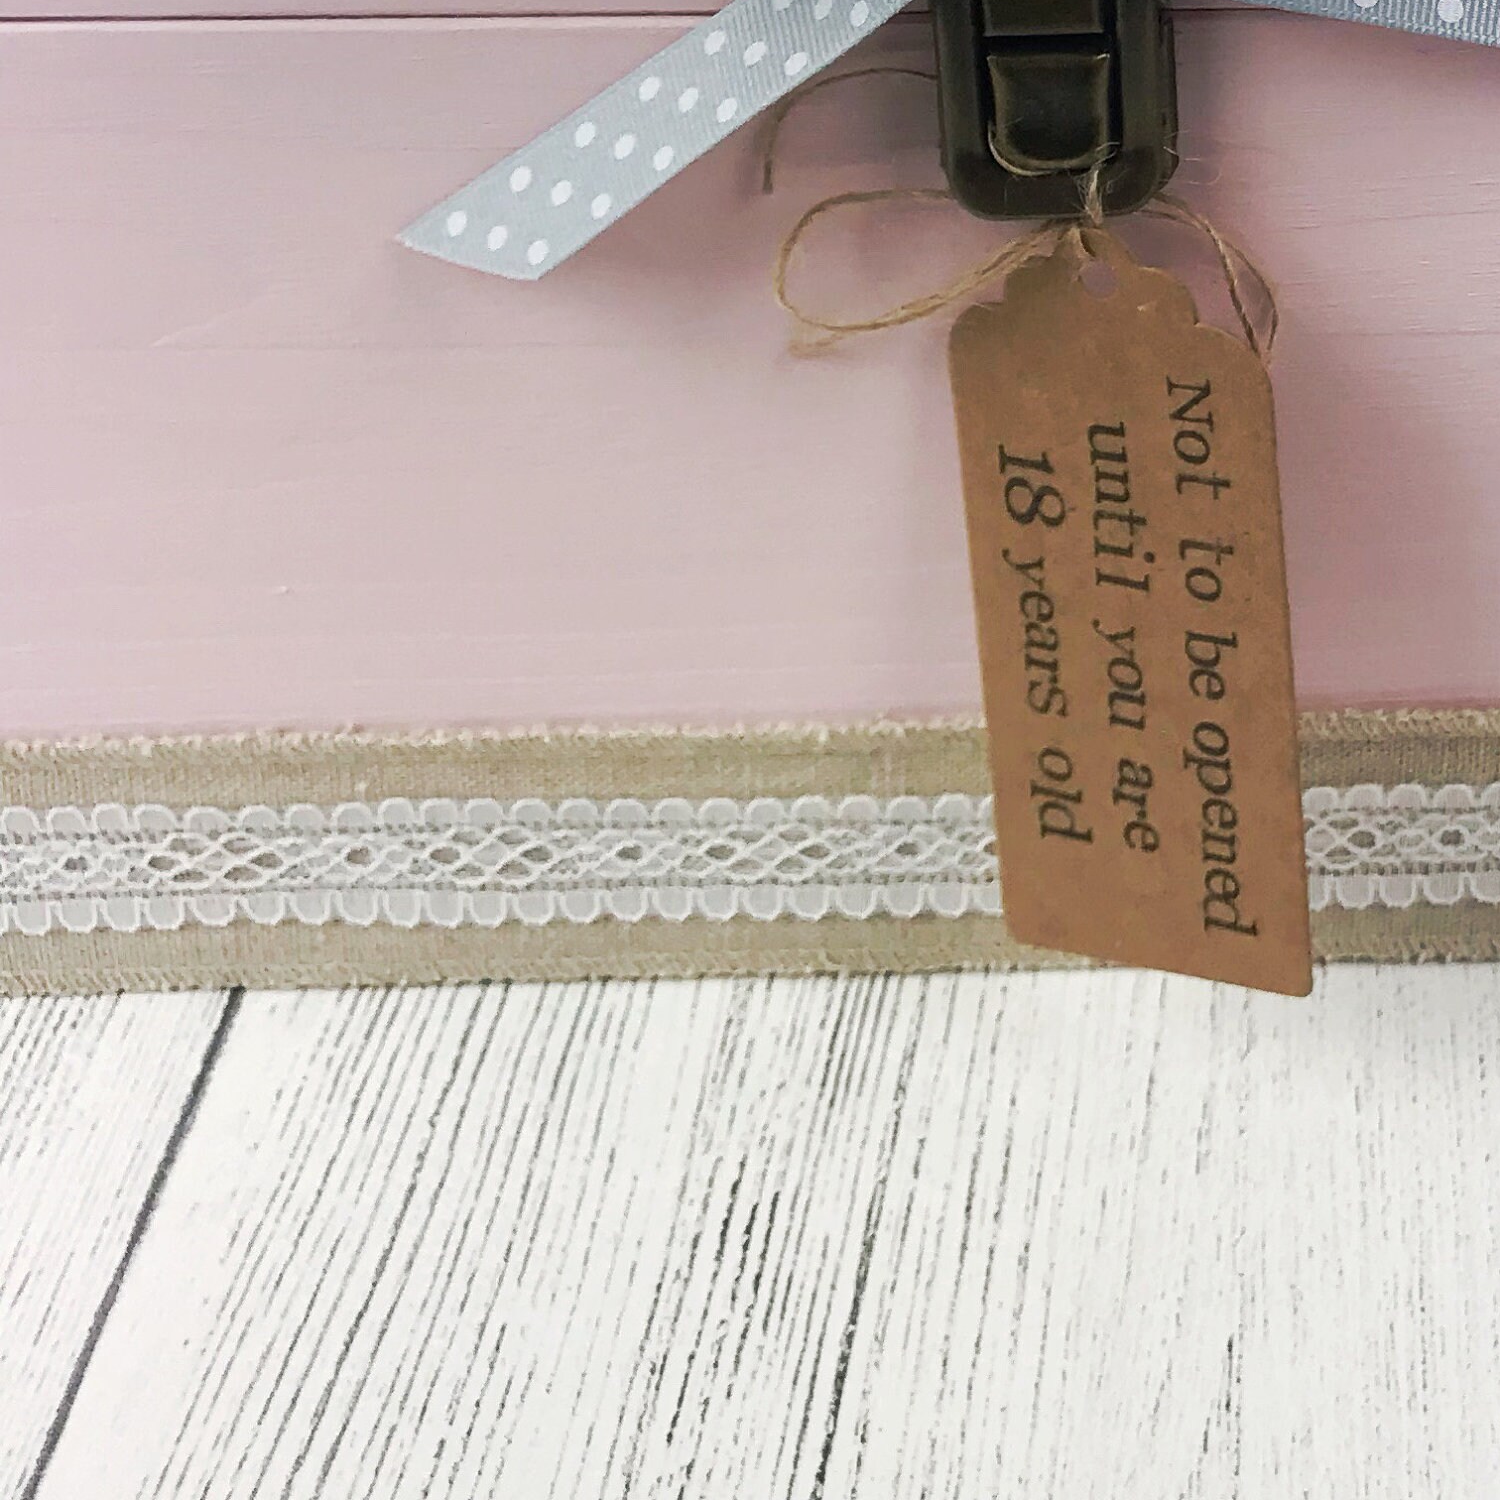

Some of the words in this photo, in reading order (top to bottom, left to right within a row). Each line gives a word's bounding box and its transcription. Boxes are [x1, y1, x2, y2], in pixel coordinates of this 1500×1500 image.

[998, 444, 1066, 529] 18
[1166, 375, 1232, 500] Not
[1087, 421, 1156, 593] until
[1178, 538, 1235, 603] to
[1002, 547, 1069, 719] years
[1092, 618, 1147, 731] you
[1184, 630, 1239, 701] be
[1030, 746, 1094, 845] old
[1112, 757, 1160, 854] are
[1183, 721, 1258, 937] opened
